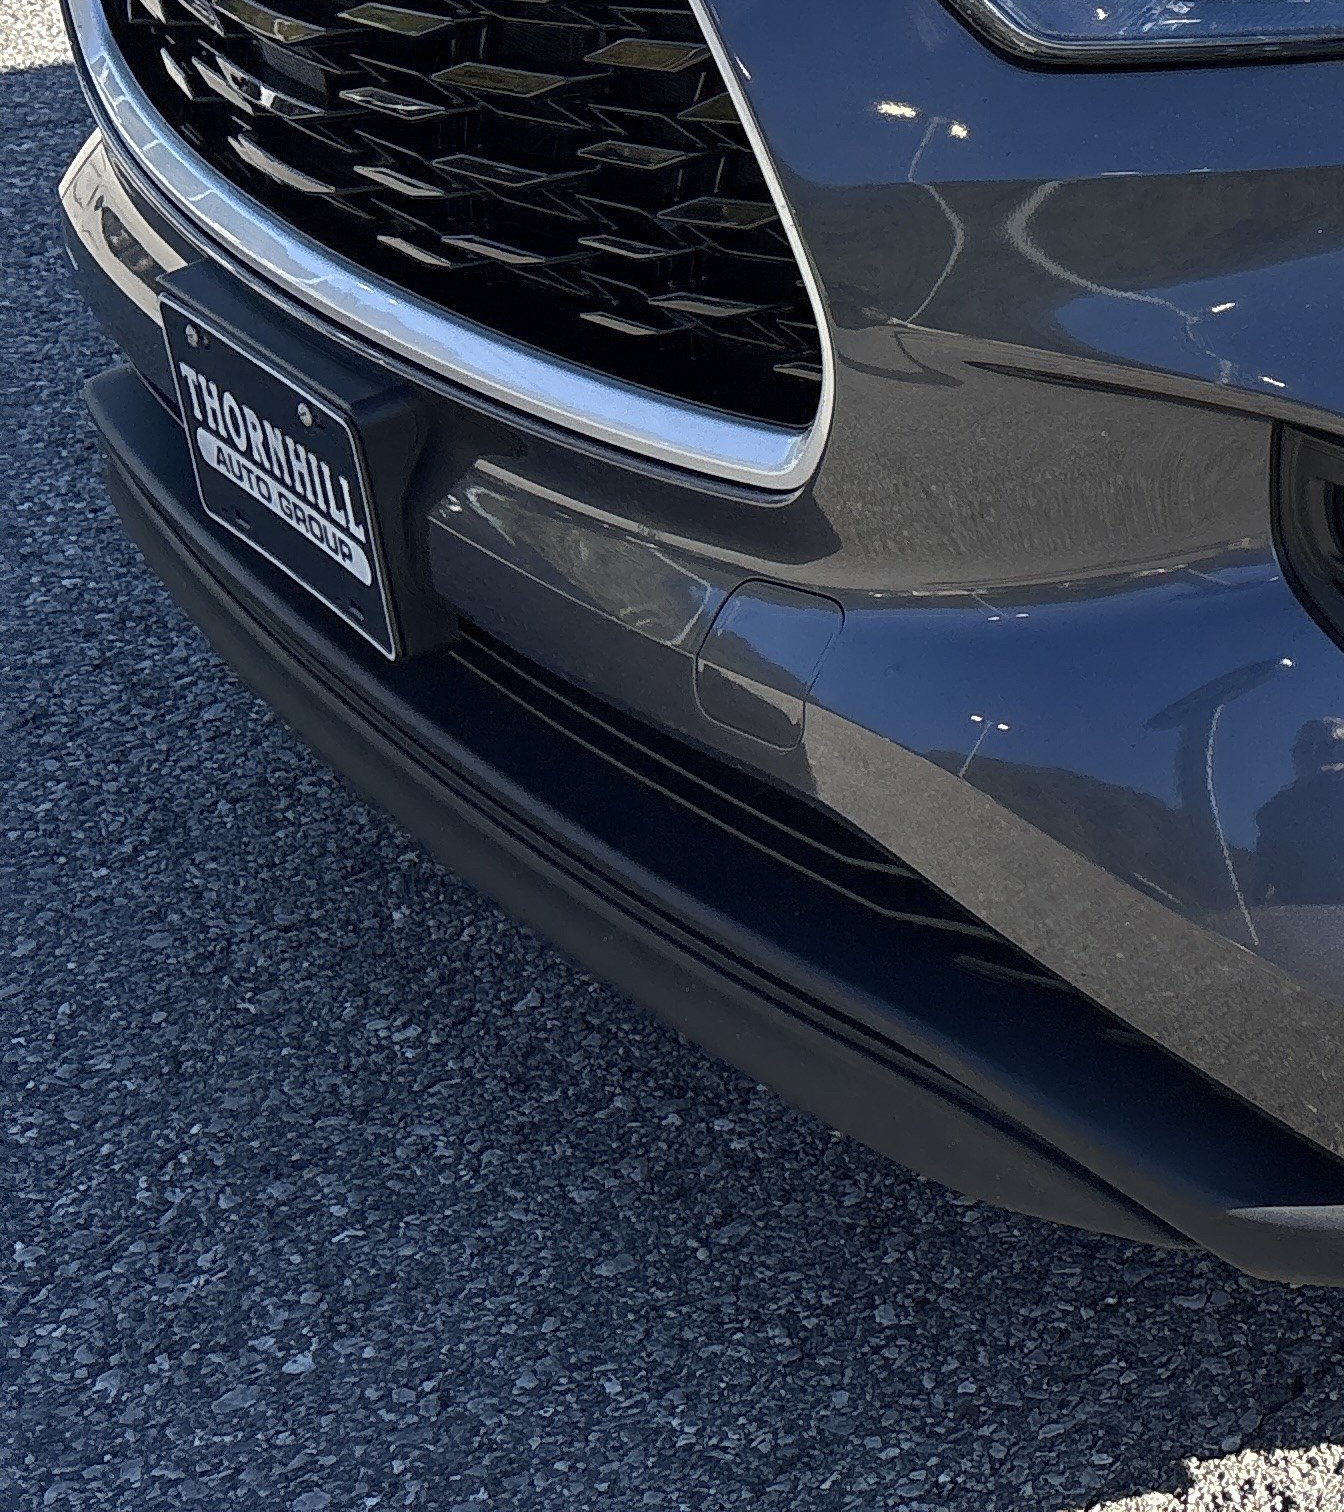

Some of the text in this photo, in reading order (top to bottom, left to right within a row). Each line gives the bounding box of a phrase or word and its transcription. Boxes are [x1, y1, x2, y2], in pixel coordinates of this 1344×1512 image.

[180, 361, 367, 543] THORNHILL
[214, 443, 354, 565] AUTO GROUP
